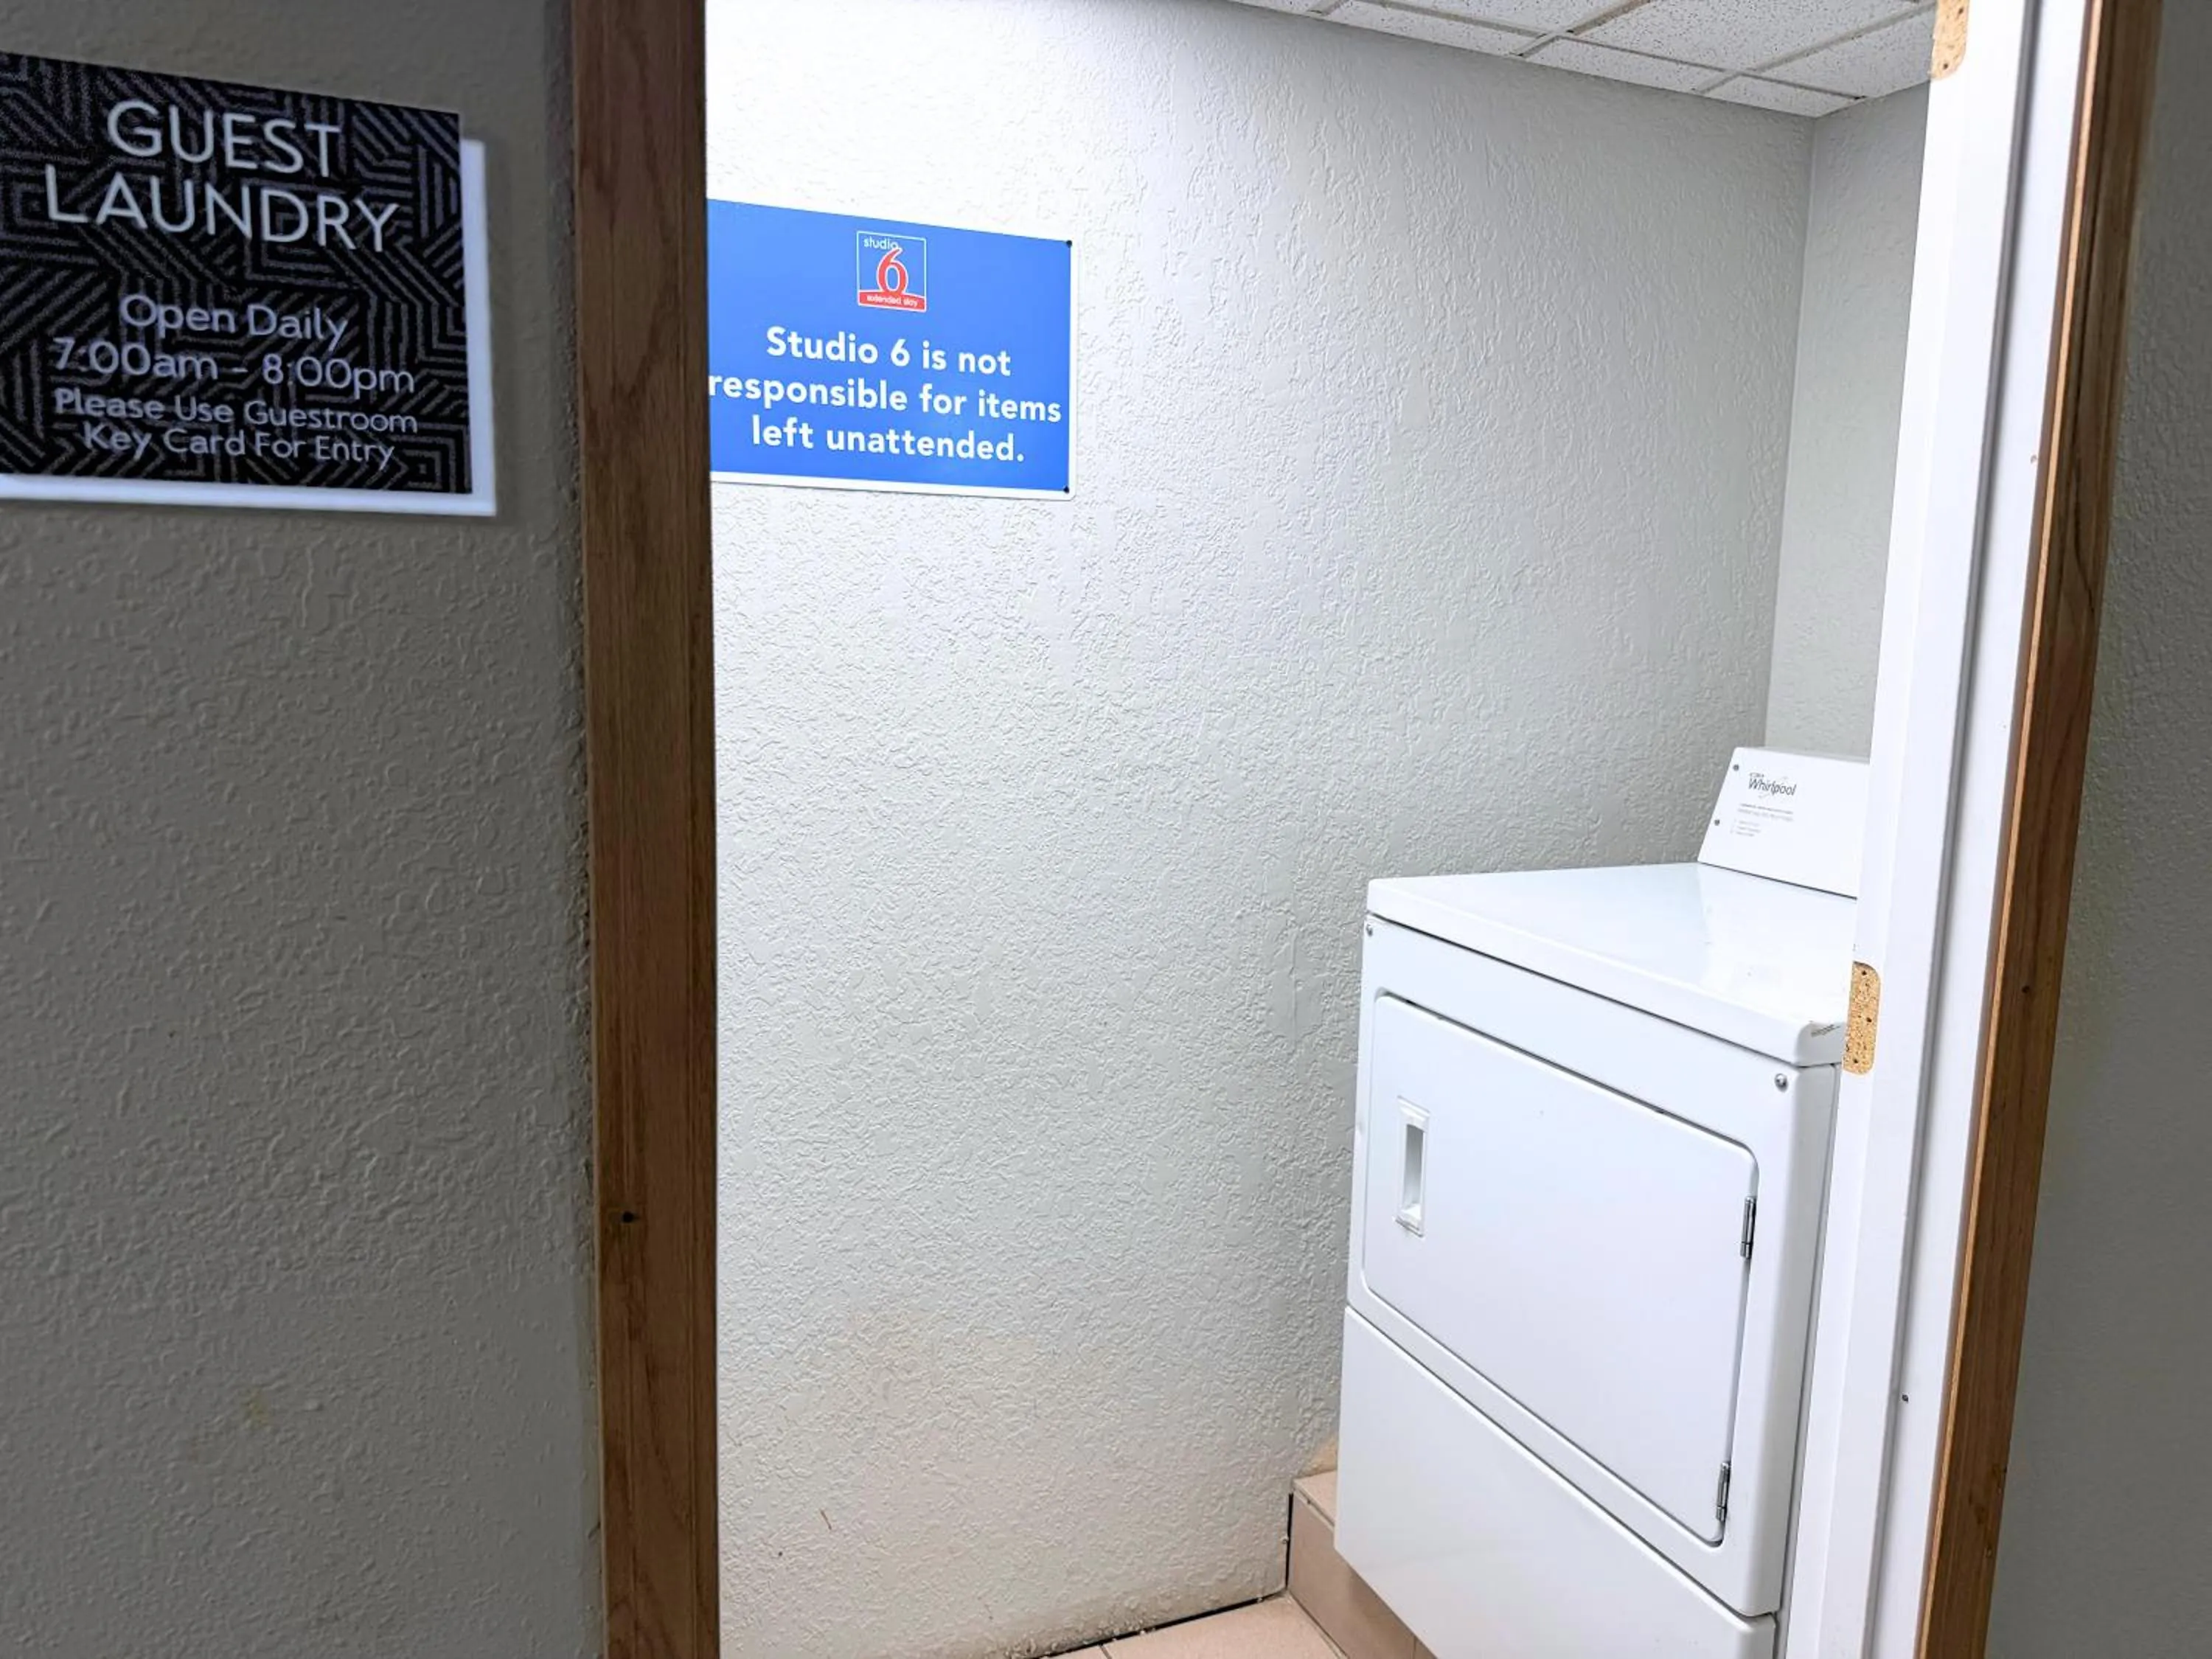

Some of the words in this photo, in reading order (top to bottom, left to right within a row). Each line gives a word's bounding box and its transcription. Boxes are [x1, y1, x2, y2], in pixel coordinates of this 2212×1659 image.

[107, 99, 341, 177] GUEST
[44, 164, 399, 251] LAUNDRY
[863, 236, 899, 249] studio
[876, 247, 908, 294] 6
[119, 295, 236, 338] Open
[247, 303, 347, 351] Daily
[866, 295, 901, 305] extended
[53, 337, 218, 380] 7:00am
[262, 353, 415, 399] 8:00pm
[766, 326, 879, 364] Studio
[890, 339, 910, 366] 6
[922, 340, 947, 370] is
[959, 350, 1011, 376] not
[53, 387, 165, 420] Please
[174, 396, 234, 424] Use
[244, 400, 417, 434] Guestroom
[708, 375, 908, 409] responsible
[919, 383, 967, 415] for
[978, 390, 1062, 422] items
[84, 422, 151, 460] Key
[163, 428, 245, 456] Card
[254, 432, 305, 459] For
[314, 437, 394, 470] Entry
[752, 414, 813, 449] left
[827, 429, 1024, 462] unattended.
[1748, 778, 1797, 796] Whirlpool
